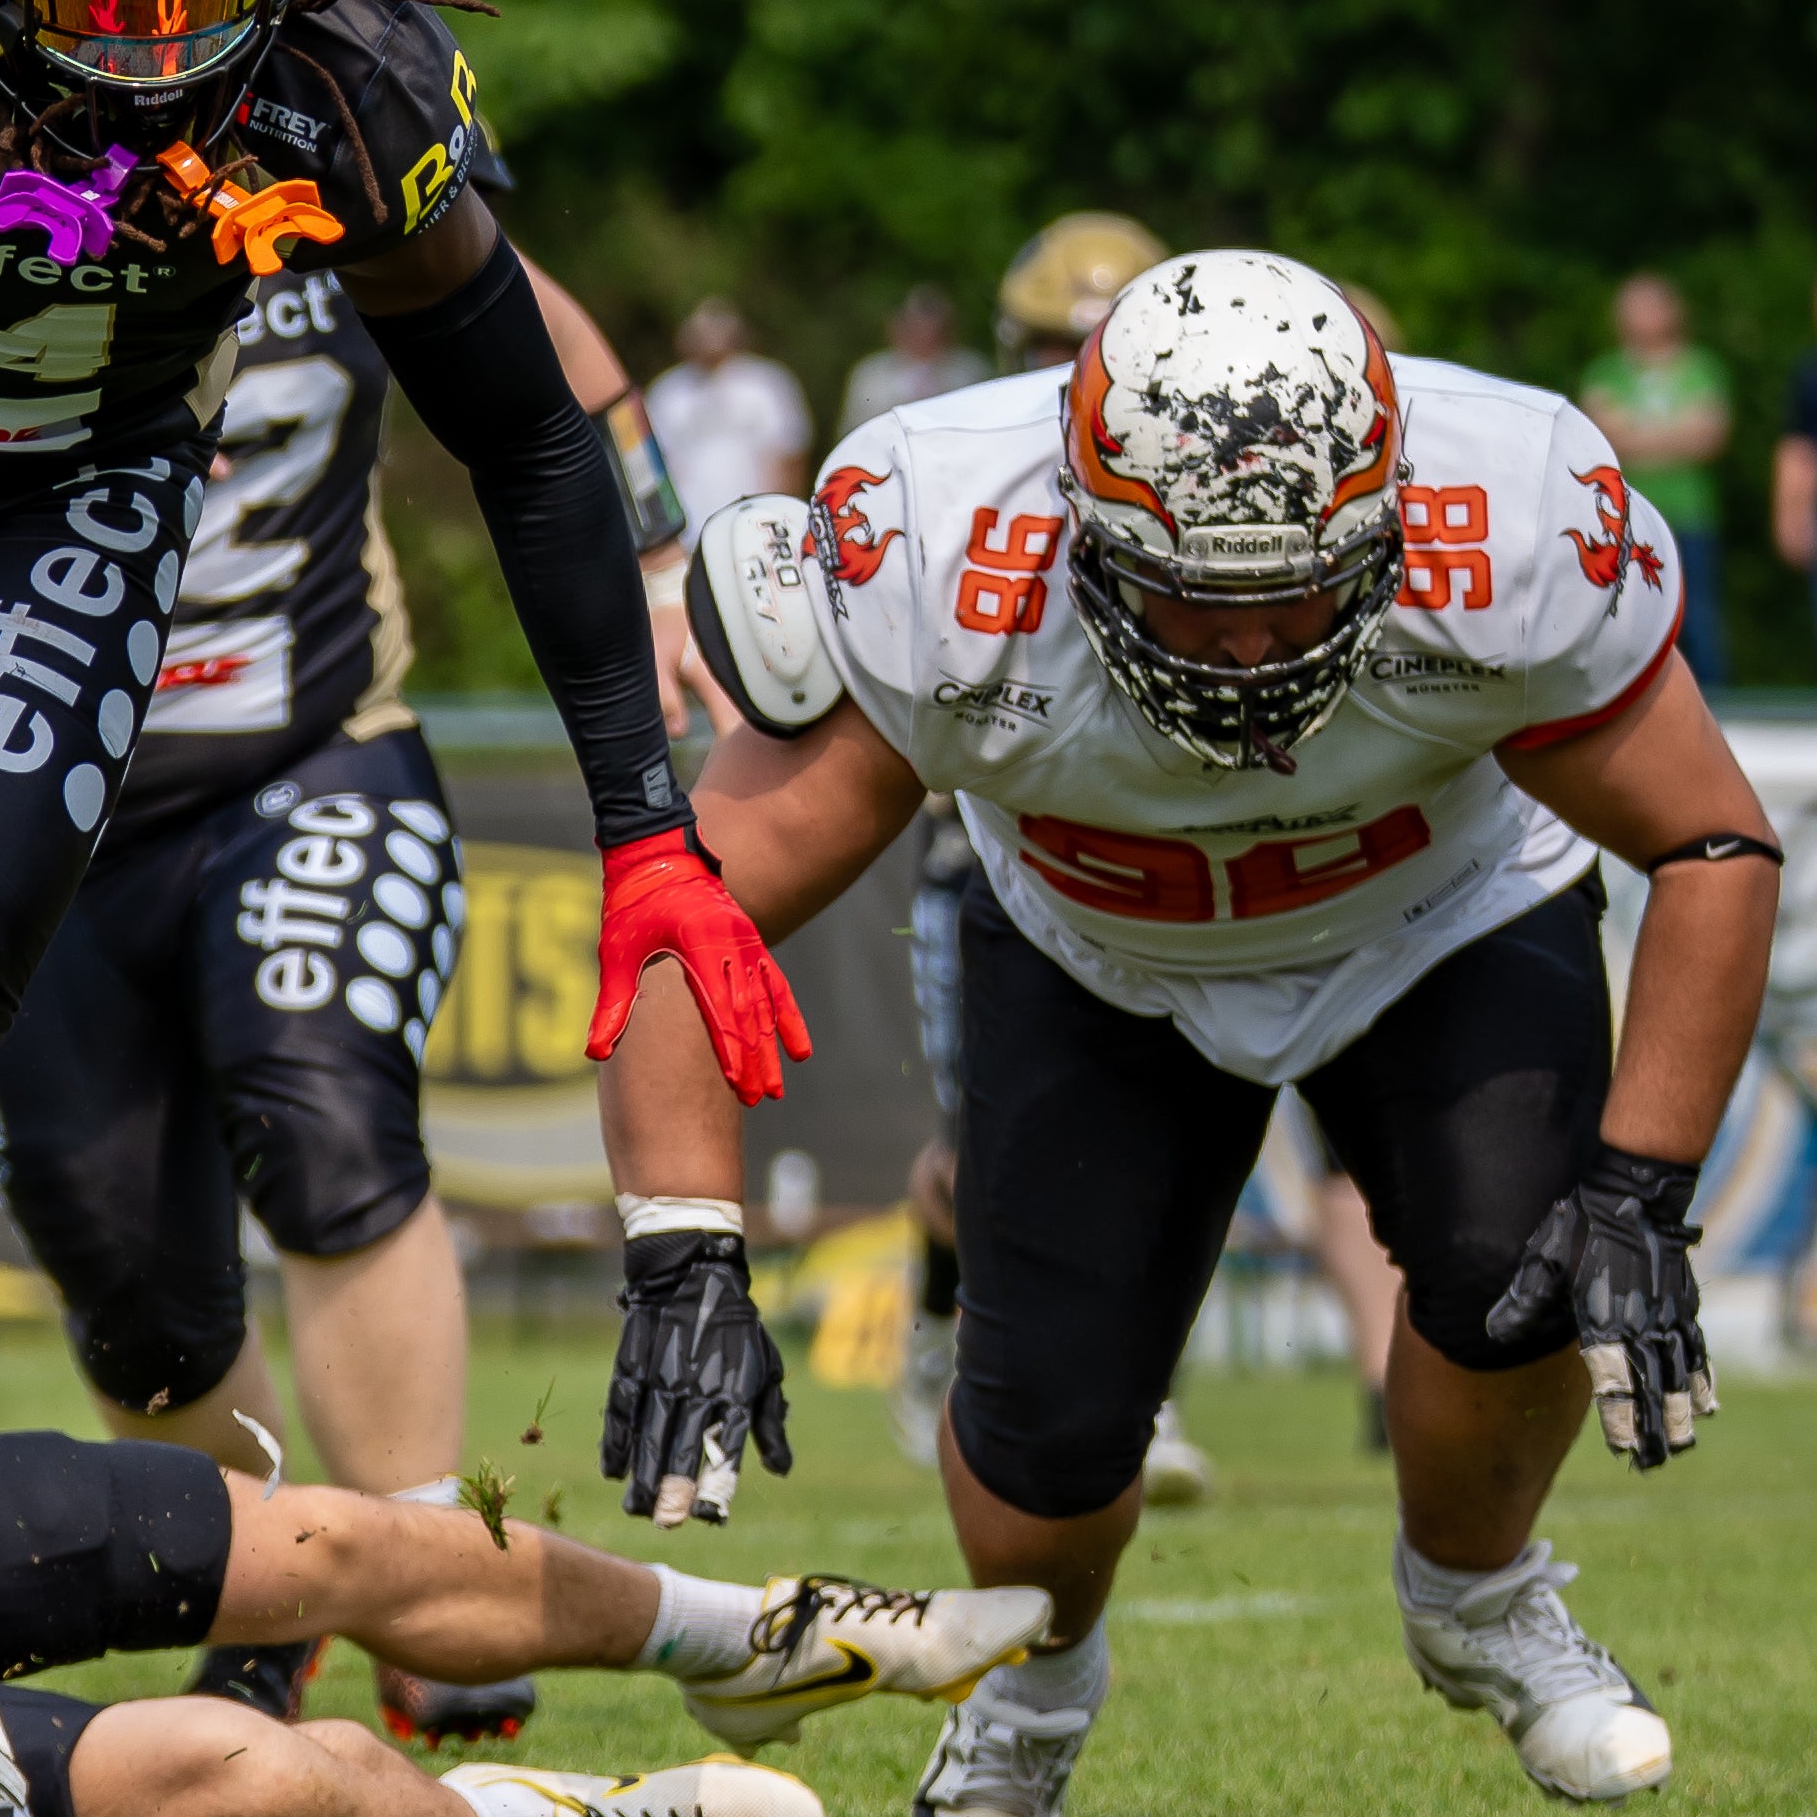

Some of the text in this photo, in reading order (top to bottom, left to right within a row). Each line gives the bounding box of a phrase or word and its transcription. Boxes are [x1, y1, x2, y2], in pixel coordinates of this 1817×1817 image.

[134, 89, 183, 106] Riddell
[249, 119, 318, 153] NUTRITION
[253, 98, 327, 140] FREY
[1212, 536, 1282, 555] Riddell
[1395, 485, 1493, 611] 98
[954, 506, 1065, 636] 98
[236, 792, 377, 1013] effec
